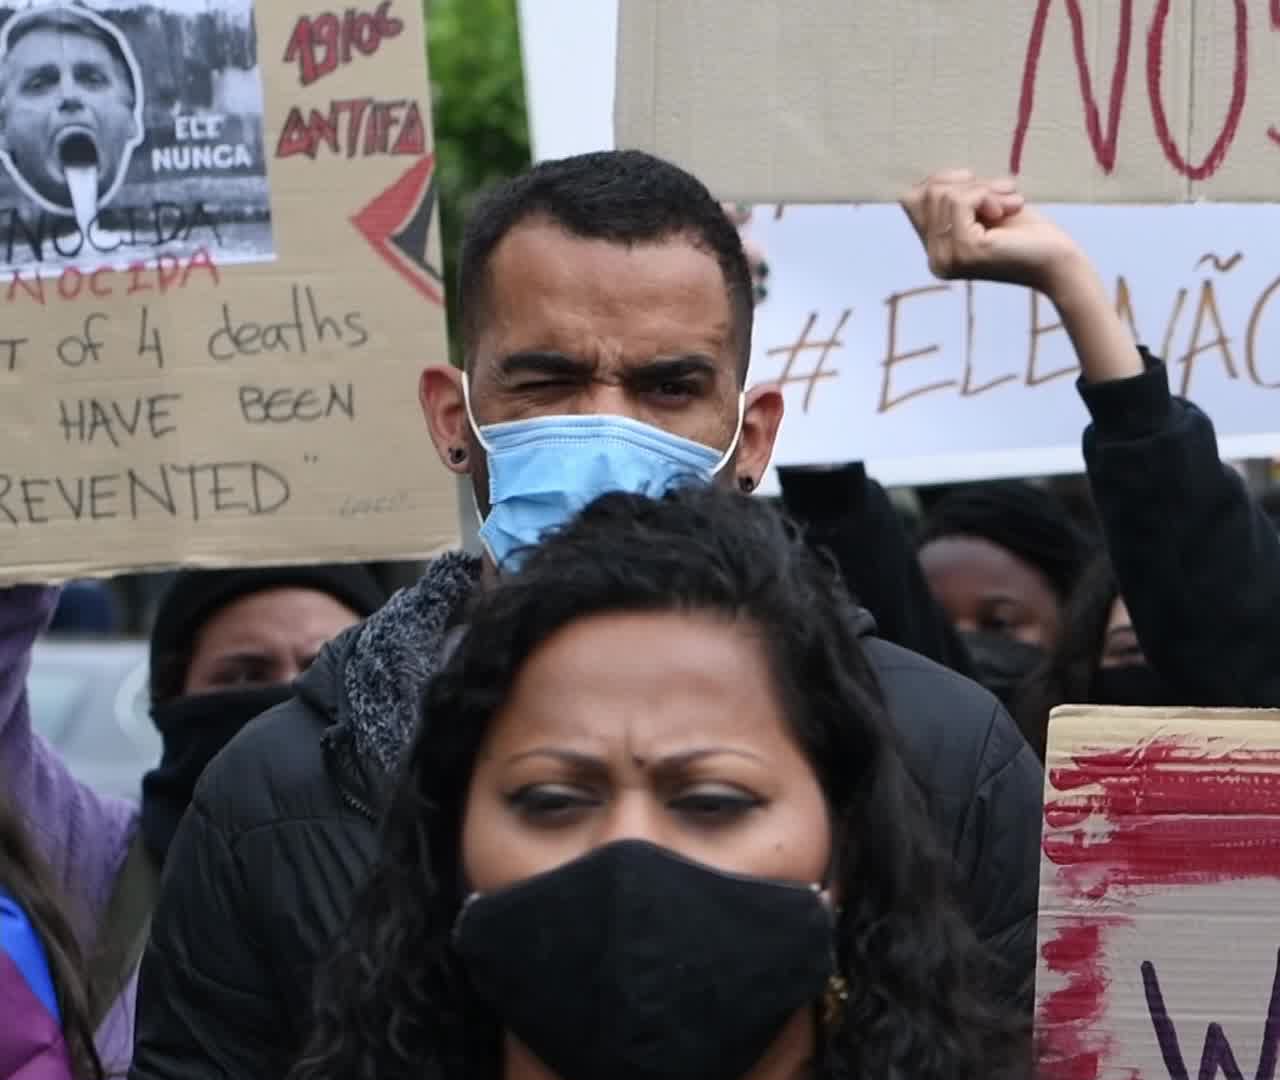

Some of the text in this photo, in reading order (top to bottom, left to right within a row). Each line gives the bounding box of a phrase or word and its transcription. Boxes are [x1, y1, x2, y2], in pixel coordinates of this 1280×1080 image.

[151, 144, 253, 173] NUNCA
[274, 97, 427, 161] ANTIFA
[6, 246, 221, 302] NOCIDA
[56, 312, 109, 368] of
[137, 304, 165, 369] 4
[207, 283, 370, 361] deaths
[57, 383, 356, 448] HAVE BEEN
